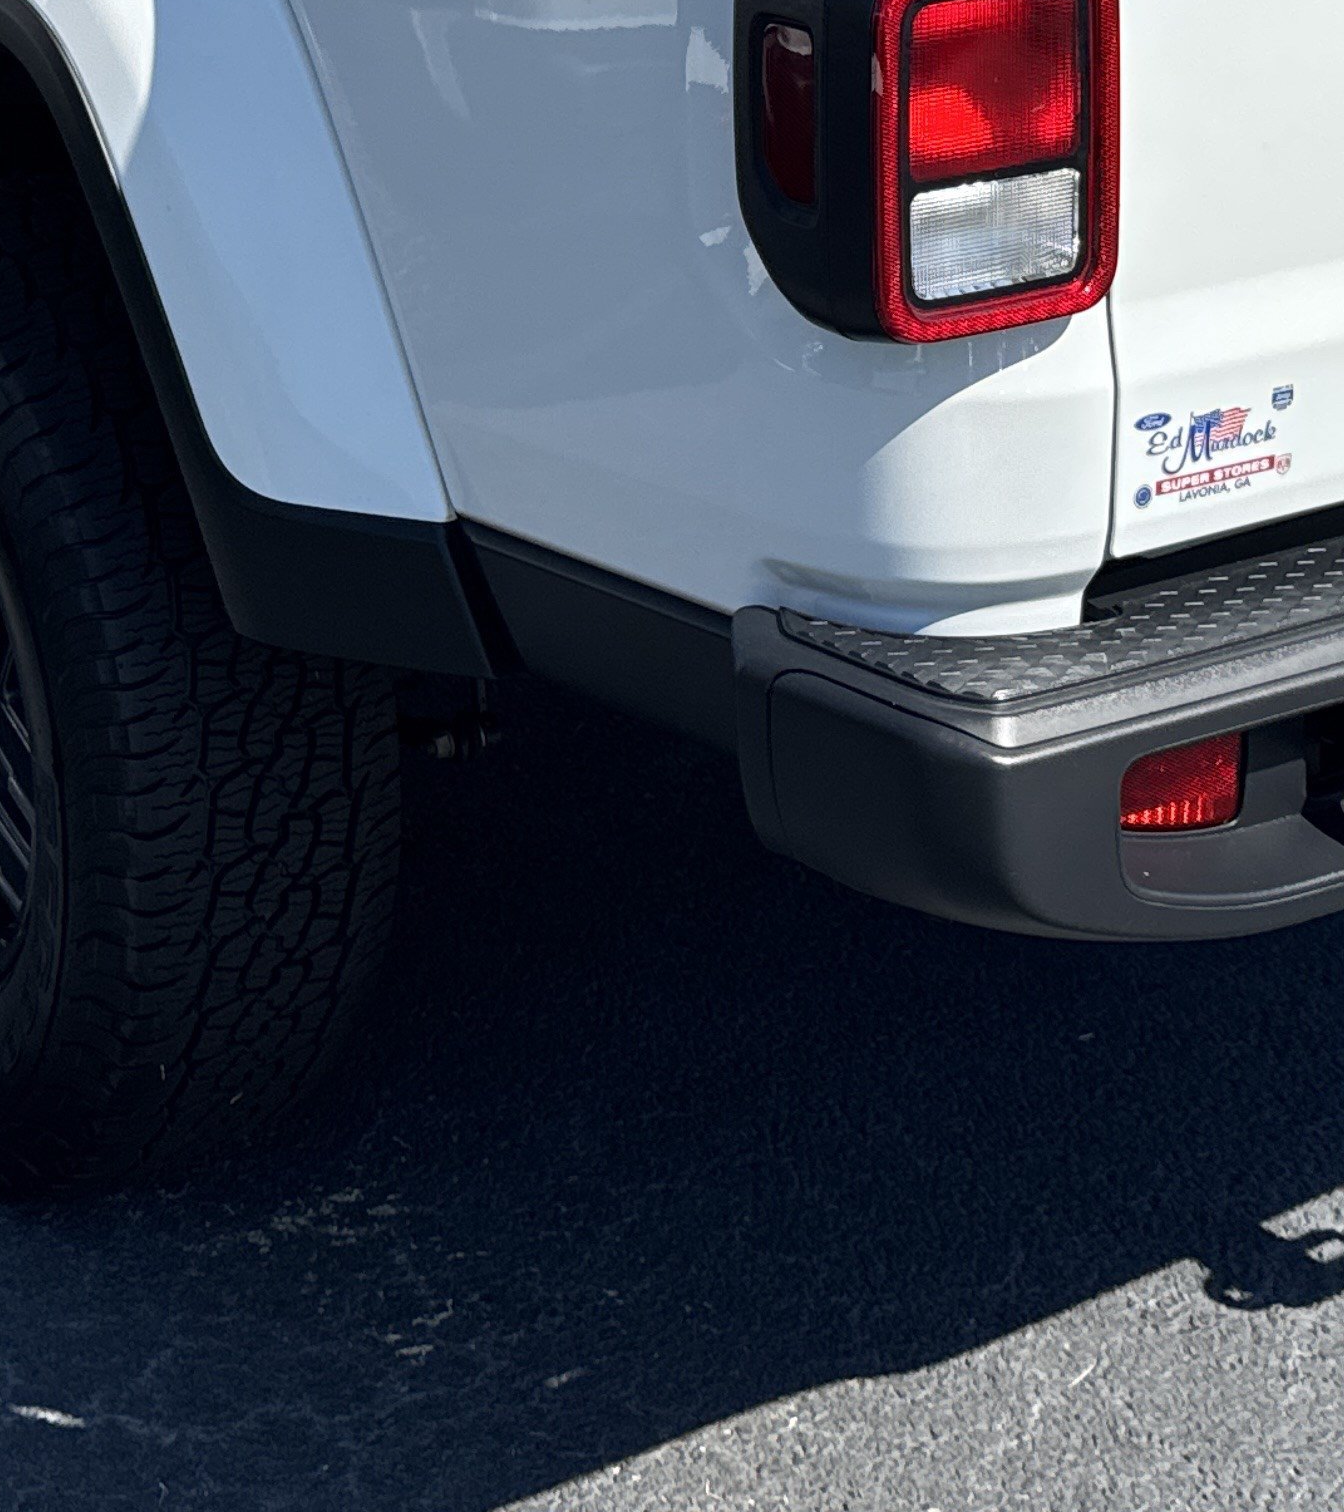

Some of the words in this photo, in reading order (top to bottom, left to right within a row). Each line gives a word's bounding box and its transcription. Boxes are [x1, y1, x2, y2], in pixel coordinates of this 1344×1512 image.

[1146, 426, 1183, 456] Ed
[1162, 419, 1276, 475] Murdock
[1160, 473, 1210, 493] SUPER
[1213, 459, 1270, 481] STORES
[1179, 481, 1231, 503] LAVONIA,
[1234, 476, 1251, 490] GA
